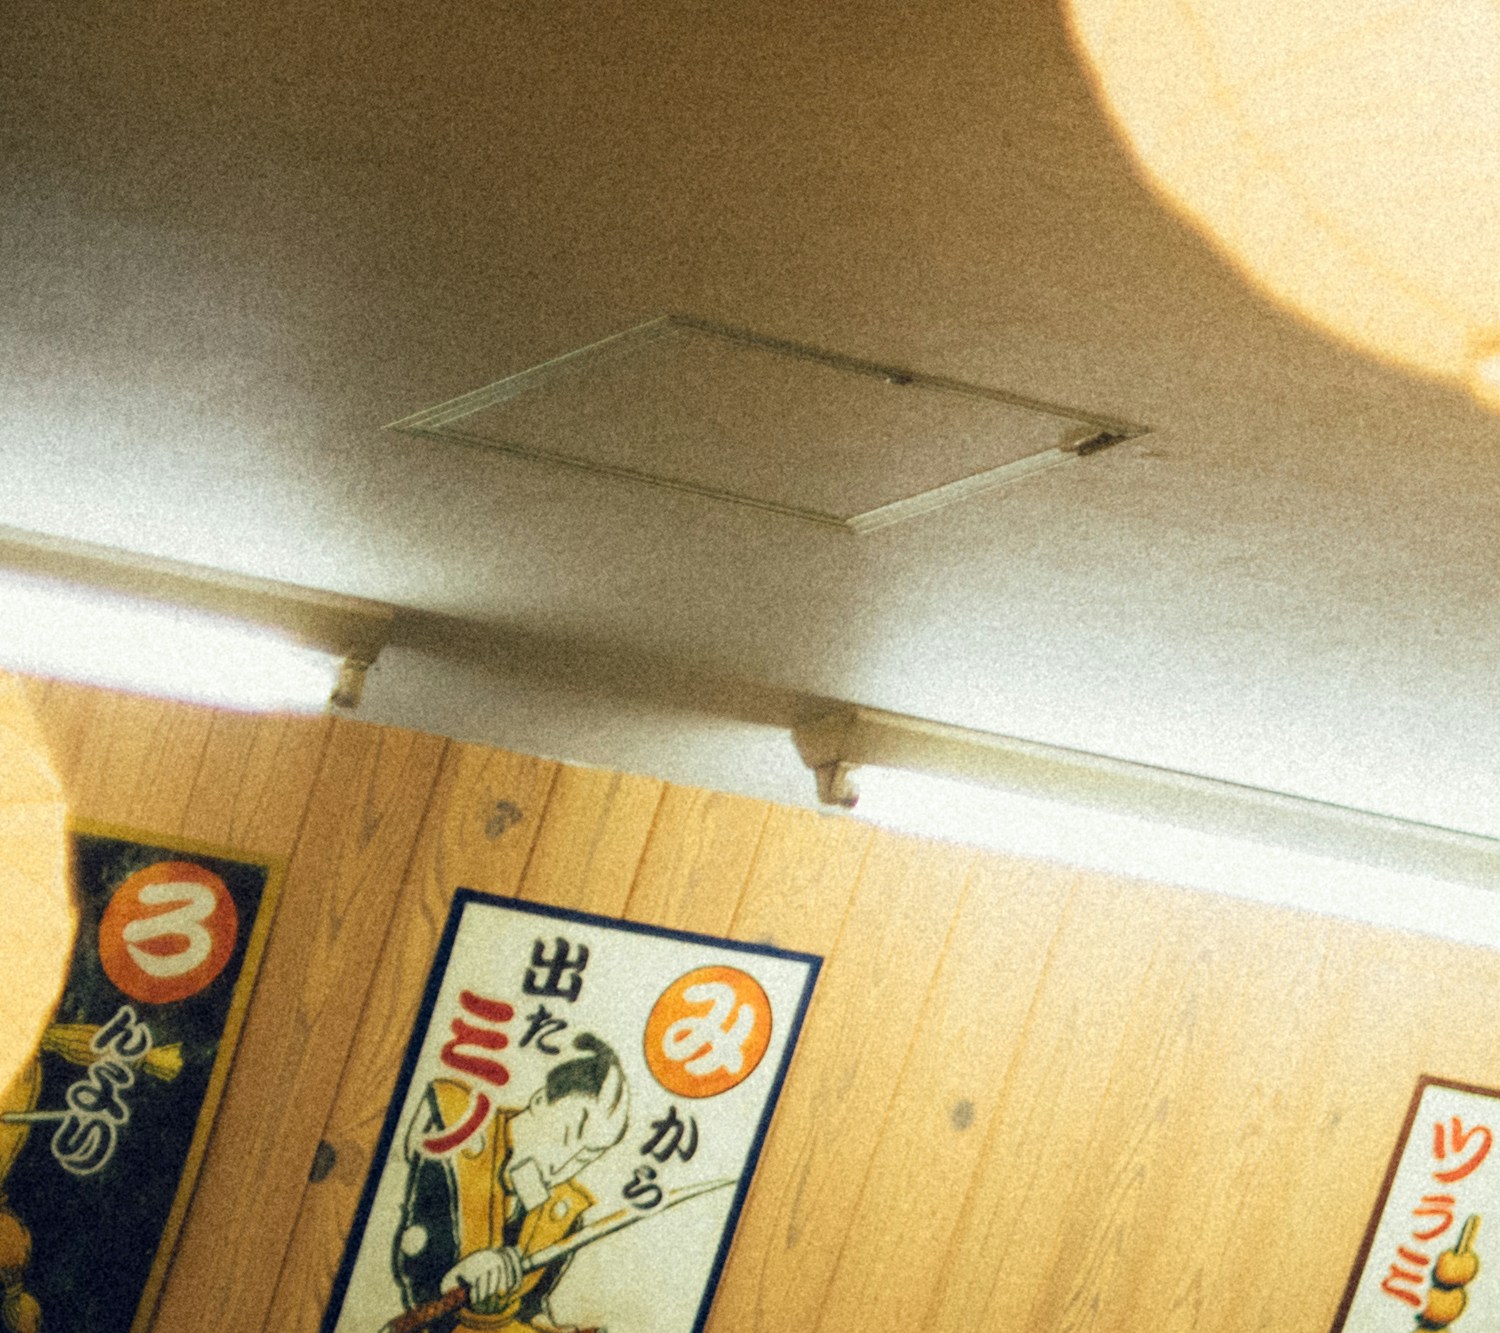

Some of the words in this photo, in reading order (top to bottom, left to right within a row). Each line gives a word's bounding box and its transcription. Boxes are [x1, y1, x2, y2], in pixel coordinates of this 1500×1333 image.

[519, 937, 589, 1055] 出た
[623, 981, 755, 1209] みから
[1381, 1117, 1493, 1308] ツラミ
